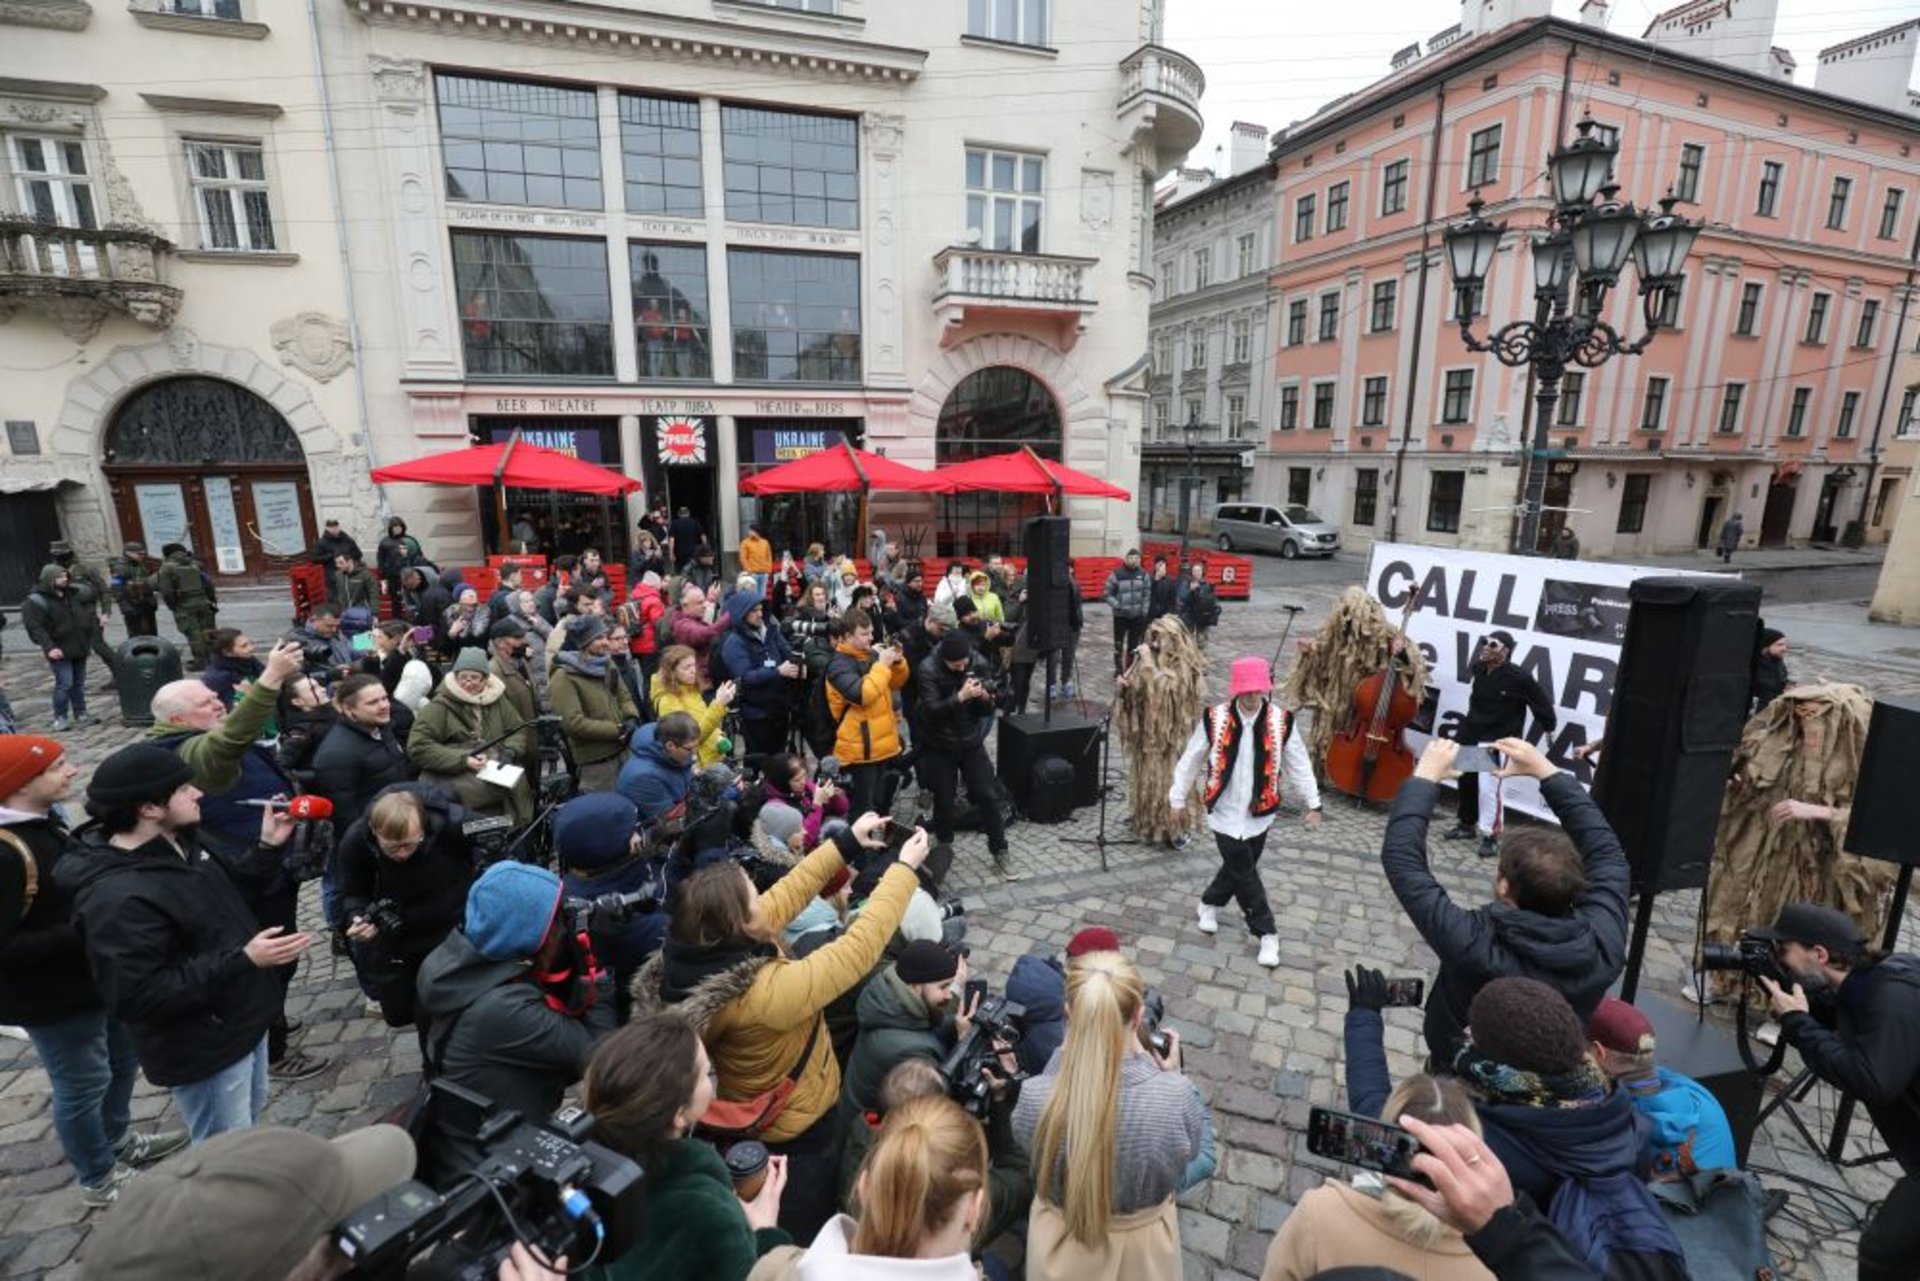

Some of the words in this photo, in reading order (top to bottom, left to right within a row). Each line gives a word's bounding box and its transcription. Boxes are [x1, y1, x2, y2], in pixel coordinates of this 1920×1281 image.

[496, 399, 528, 412] BEER
[540, 399, 597, 412] THEATRE
[774, 431, 825, 447] UKRAINE
[1378, 560, 1529, 630] CALL
[1545, 602, 1578, 616] PRESS
